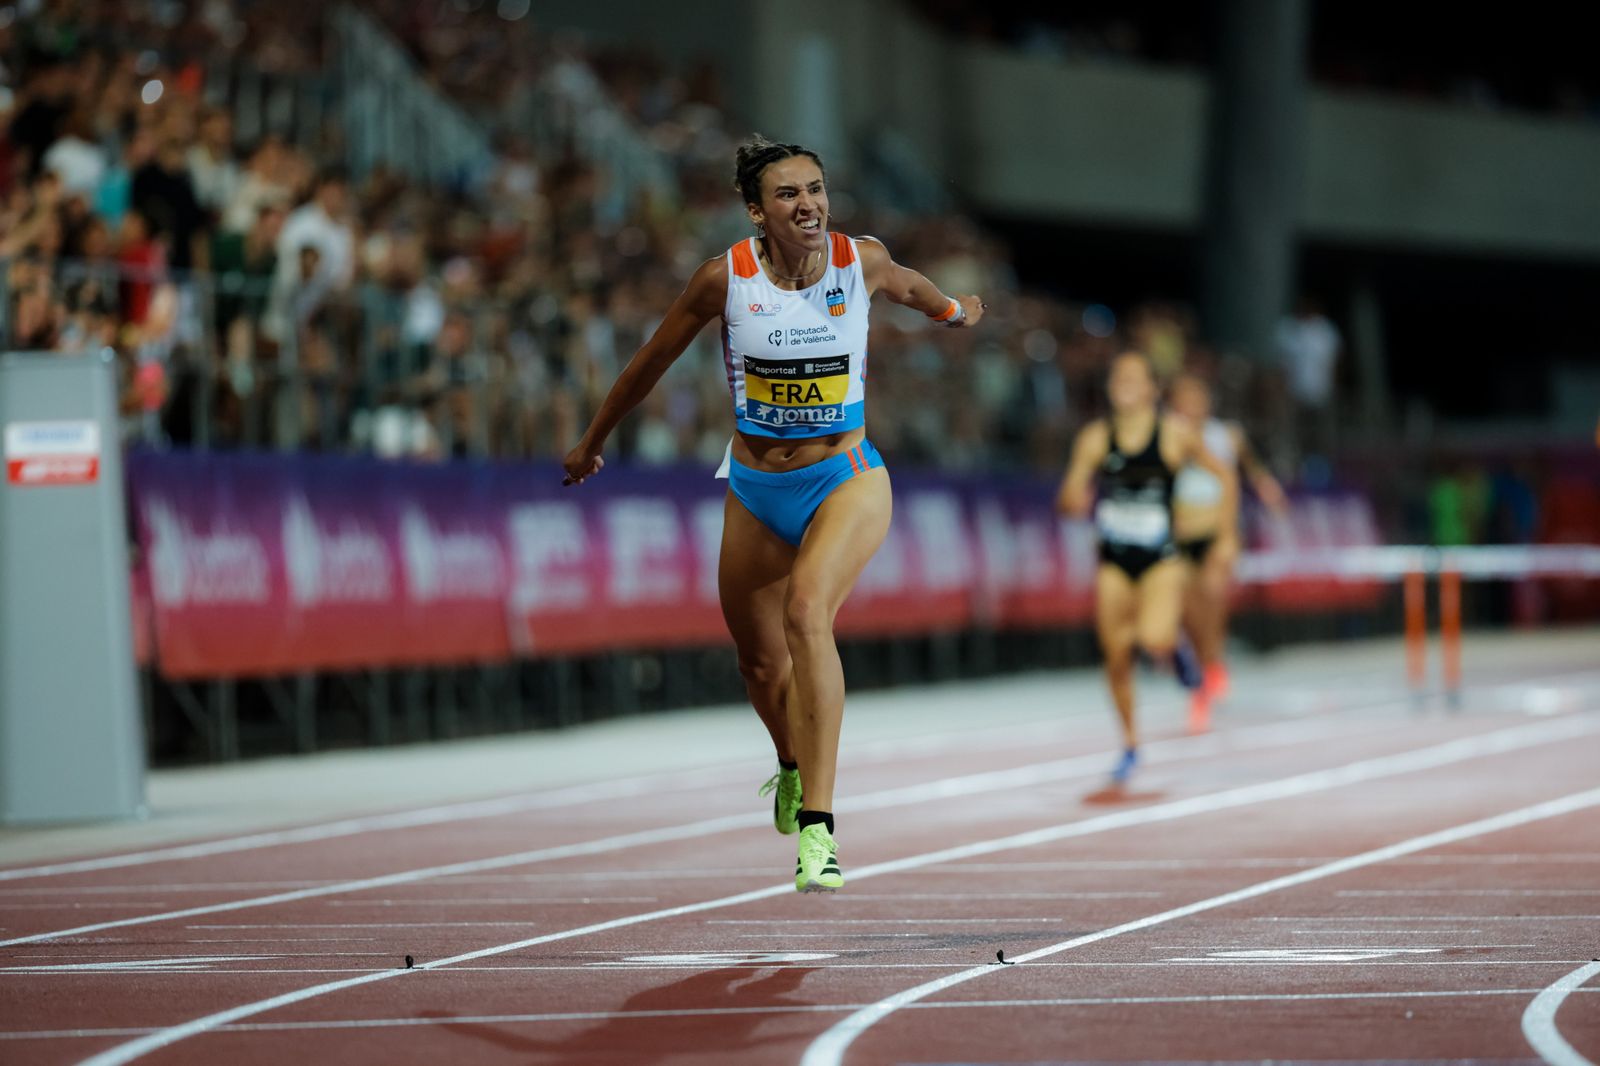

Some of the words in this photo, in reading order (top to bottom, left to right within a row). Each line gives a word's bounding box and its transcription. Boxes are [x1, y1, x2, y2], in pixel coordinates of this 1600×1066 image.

[791, 325, 828, 336] Diputació
[791, 338, 801, 346] de
[802, 335, 836, 345] València
[755, 366, 797, 375] esportcat
[822, 365, 845, 373] Catalunya
[771, 382, 824, 404] FRA
[773, 407, 838, 425] Joma
